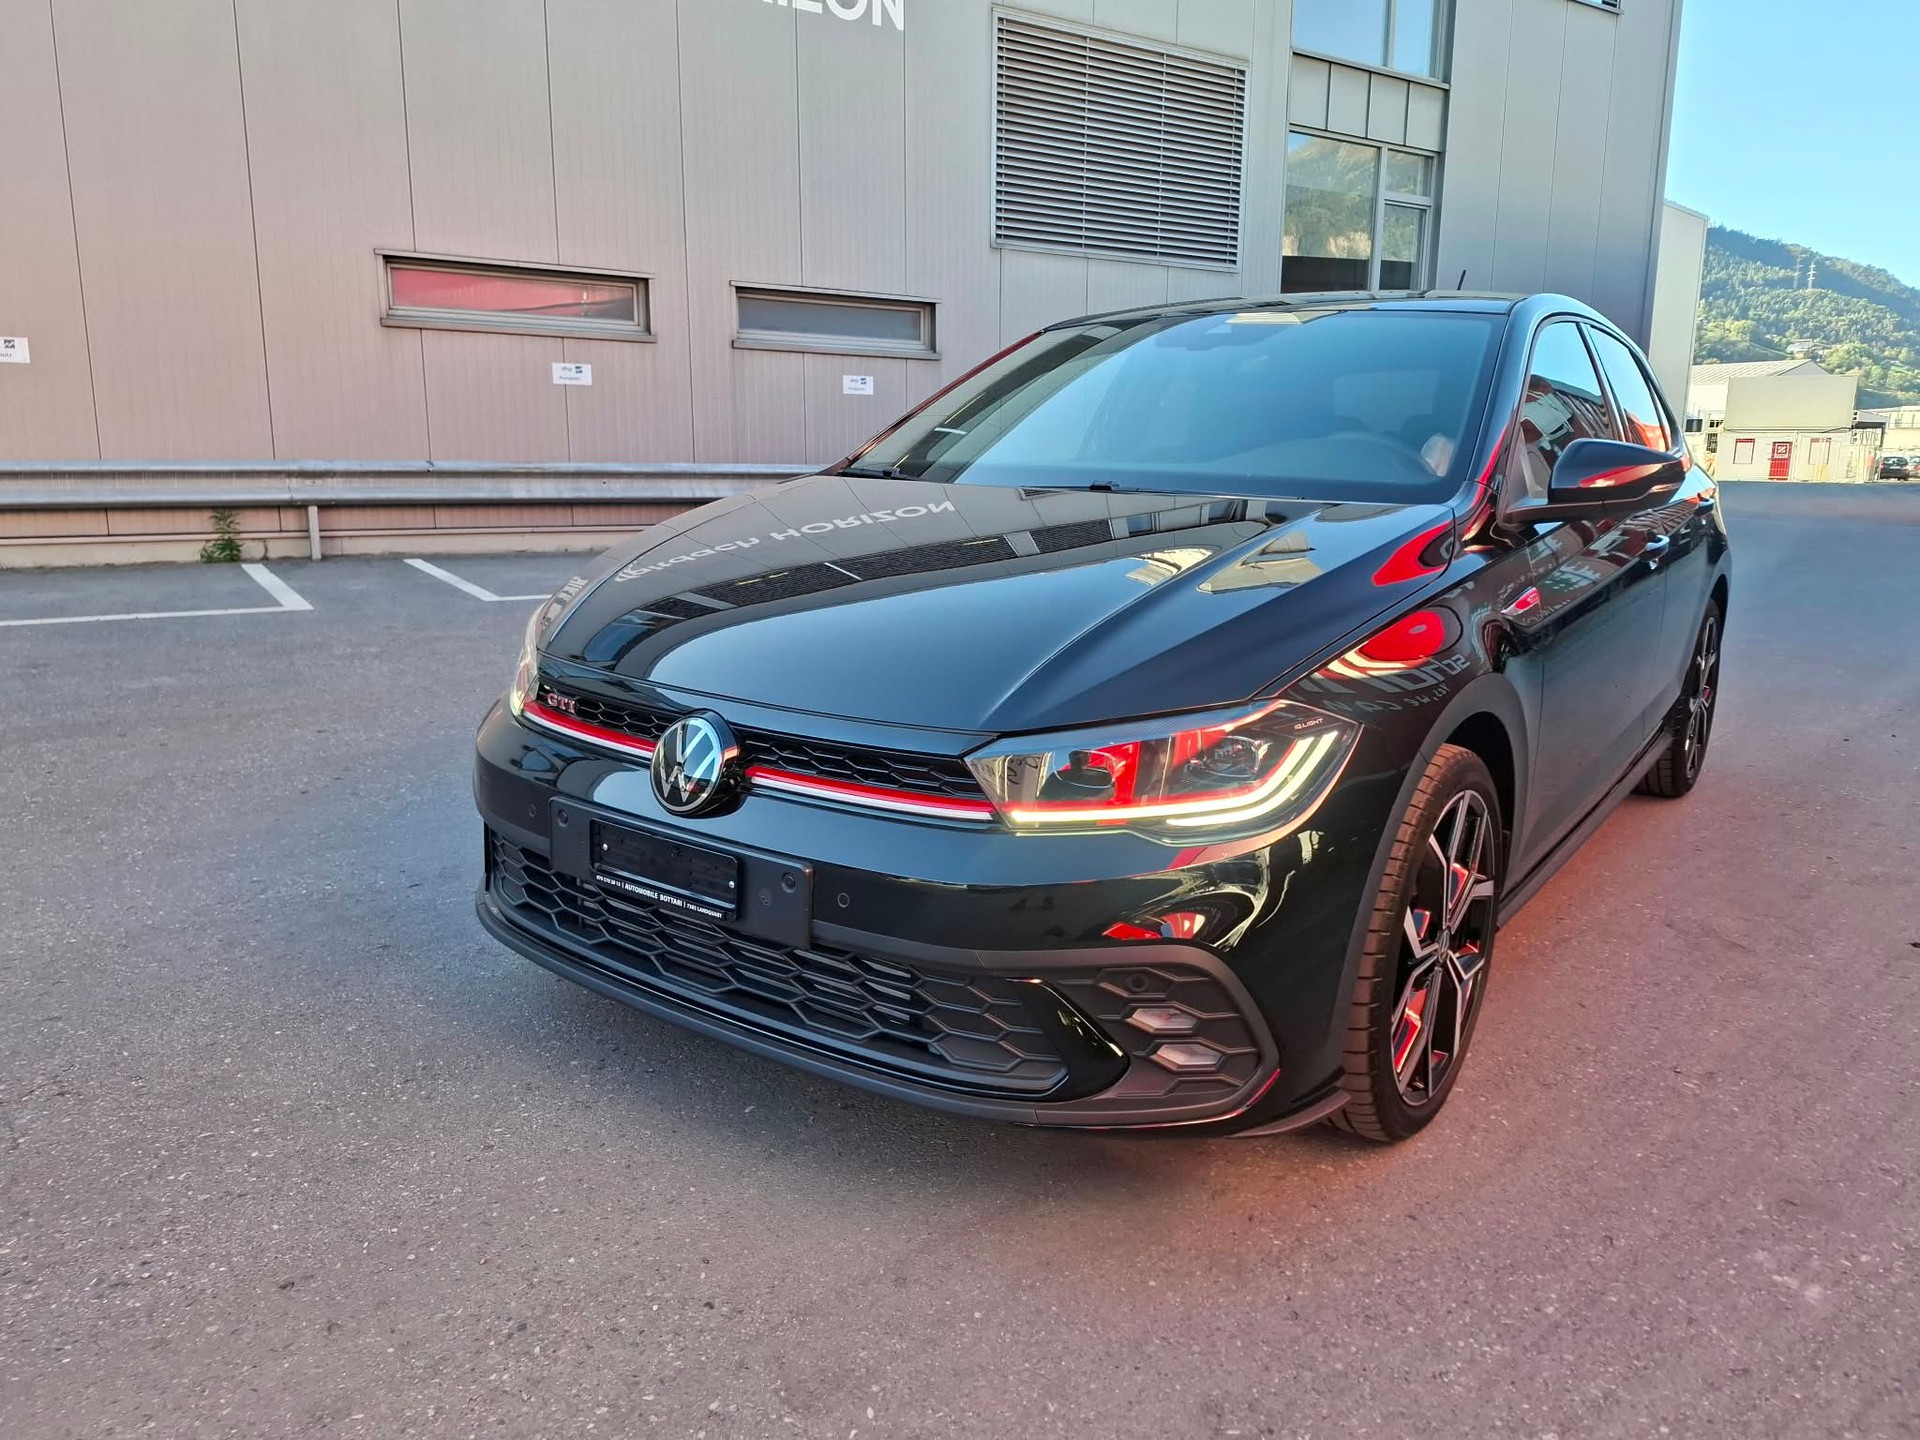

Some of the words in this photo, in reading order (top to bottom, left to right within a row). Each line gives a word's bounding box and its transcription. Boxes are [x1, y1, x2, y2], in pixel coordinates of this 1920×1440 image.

[546, 693, 576, 714] GTI
[624, 882, 658, 899] AUTOMOBILE
[659, 894, 683, 907] BOTTARI
